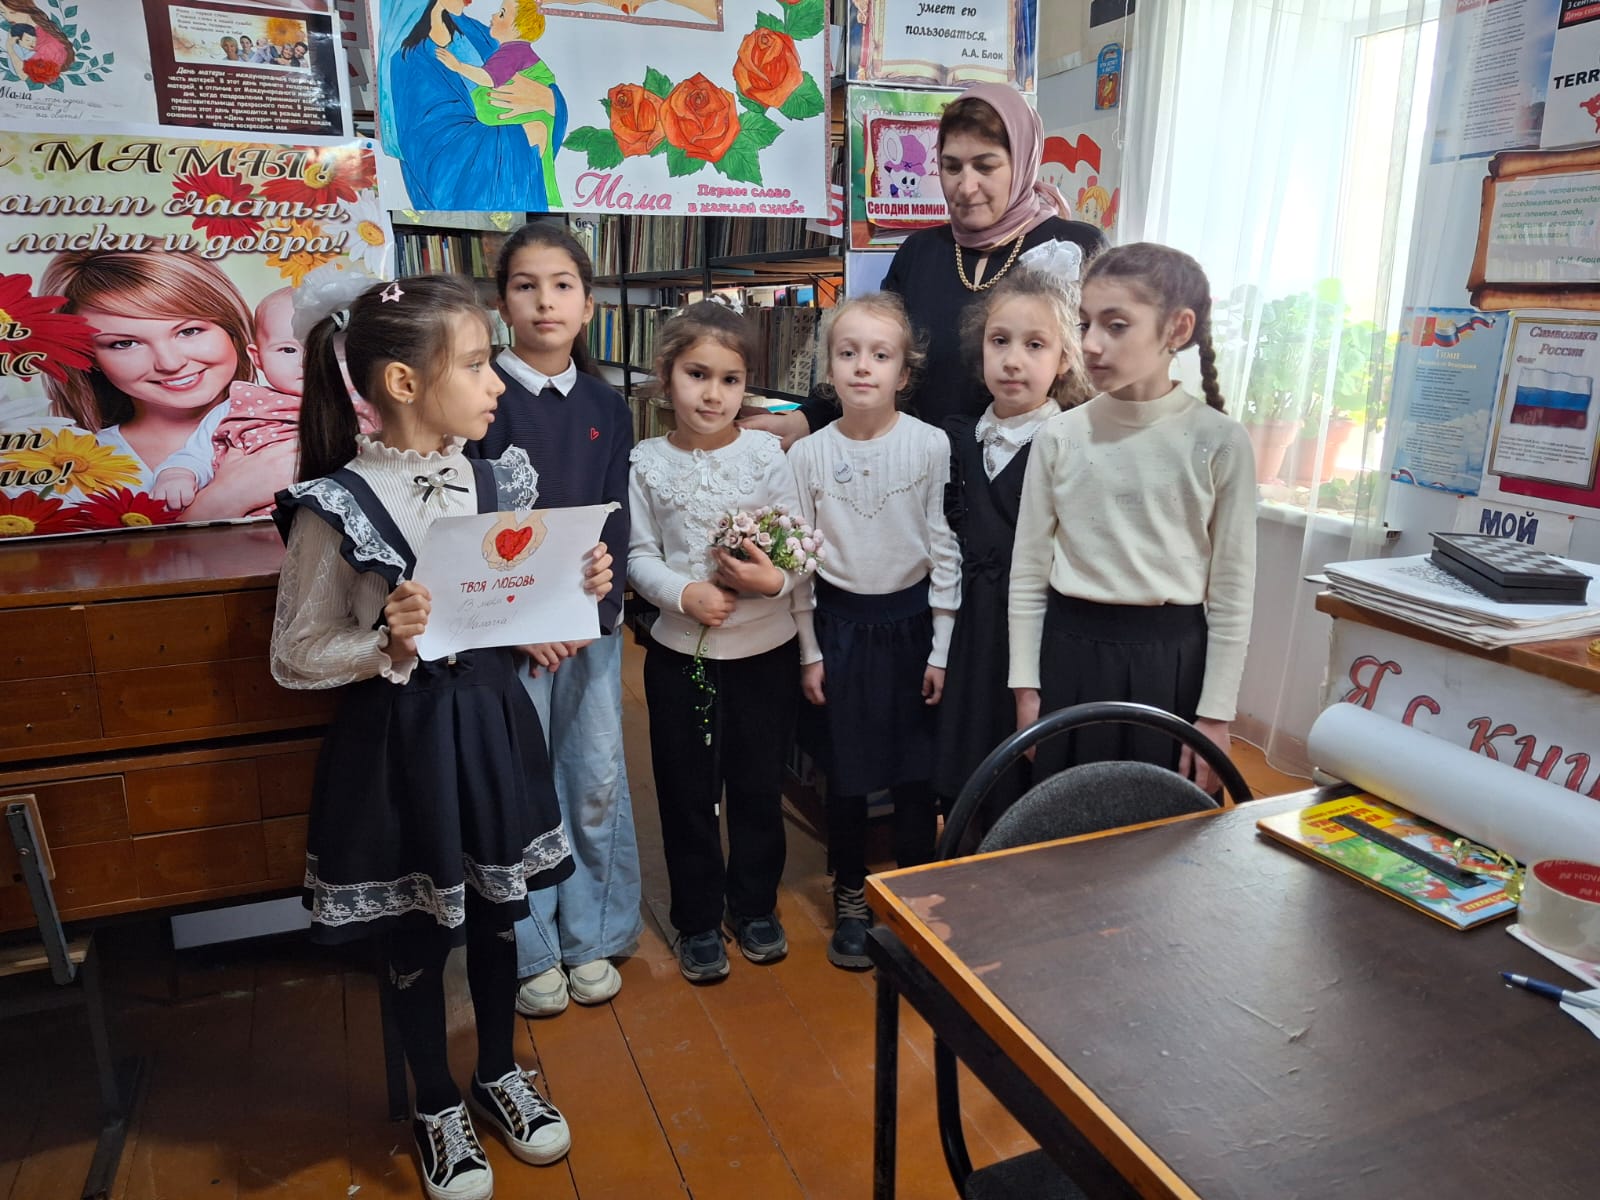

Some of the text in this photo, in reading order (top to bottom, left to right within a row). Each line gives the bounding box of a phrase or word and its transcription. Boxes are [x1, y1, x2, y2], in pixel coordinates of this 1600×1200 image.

[917, 2, 977, 17] умеет ею
[905, 24, 987, 41] пользоваться.
[961, 48, 1003, 60] А.А. Блок
[176, 66, 196, 75] День
[198, 69, 226, 77] матери
[1553, 69, 1600, 90] TERR
[34, 141, 334, 181] МАМЫ!
[573, 171, 672, 210] Мама
[751, 187, 791, 198] слово
[163, 190, 351, 224] счастья,
[867, 201, 946, 216] Сегодня мамин
[7, 223, 348, 260] ласки и добра!
[1479, 508, 1539, 545] МОЙ
[460, 574, 535, 594] ТВОЯ ЛЮБОВЬ
